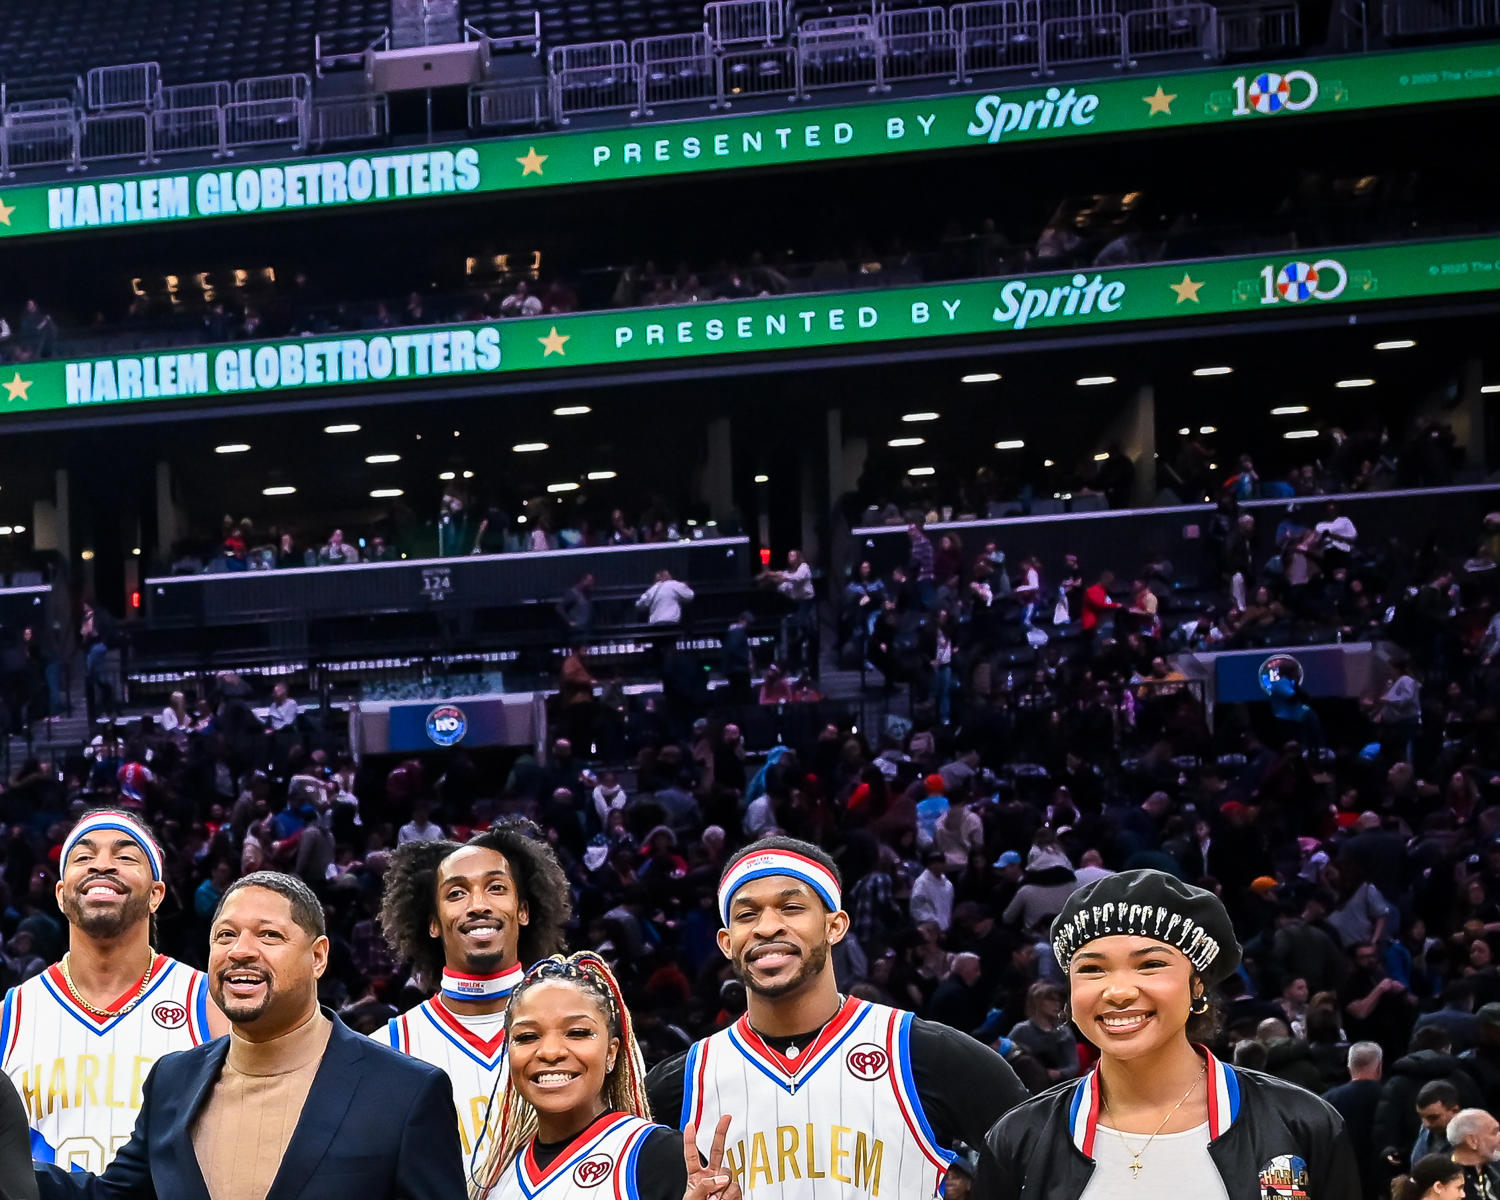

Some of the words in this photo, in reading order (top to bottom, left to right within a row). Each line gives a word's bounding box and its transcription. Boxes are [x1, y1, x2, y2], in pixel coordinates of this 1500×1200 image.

[593, 122, 854, 167] PRESENTED
[888, 114, 936, 139] BY
[967, 87, 1100, 143] Sprite
[48, 176, 190, 229] HARLEM
[196, 148, 480, 216] GLOBETROTTERS
[616, 304, 878, 347] PRESENTED
[913, 300, 961, 324] BY
[993, 274, 1126, 330] Sprite
[66, 353, 209, 404] HARLEM
[216, 327, 502, 391] GLOBETROTTERS
[22, 1052, 155, 1119] HARLE
[728, 1123, 885, 1197] HARLEM
